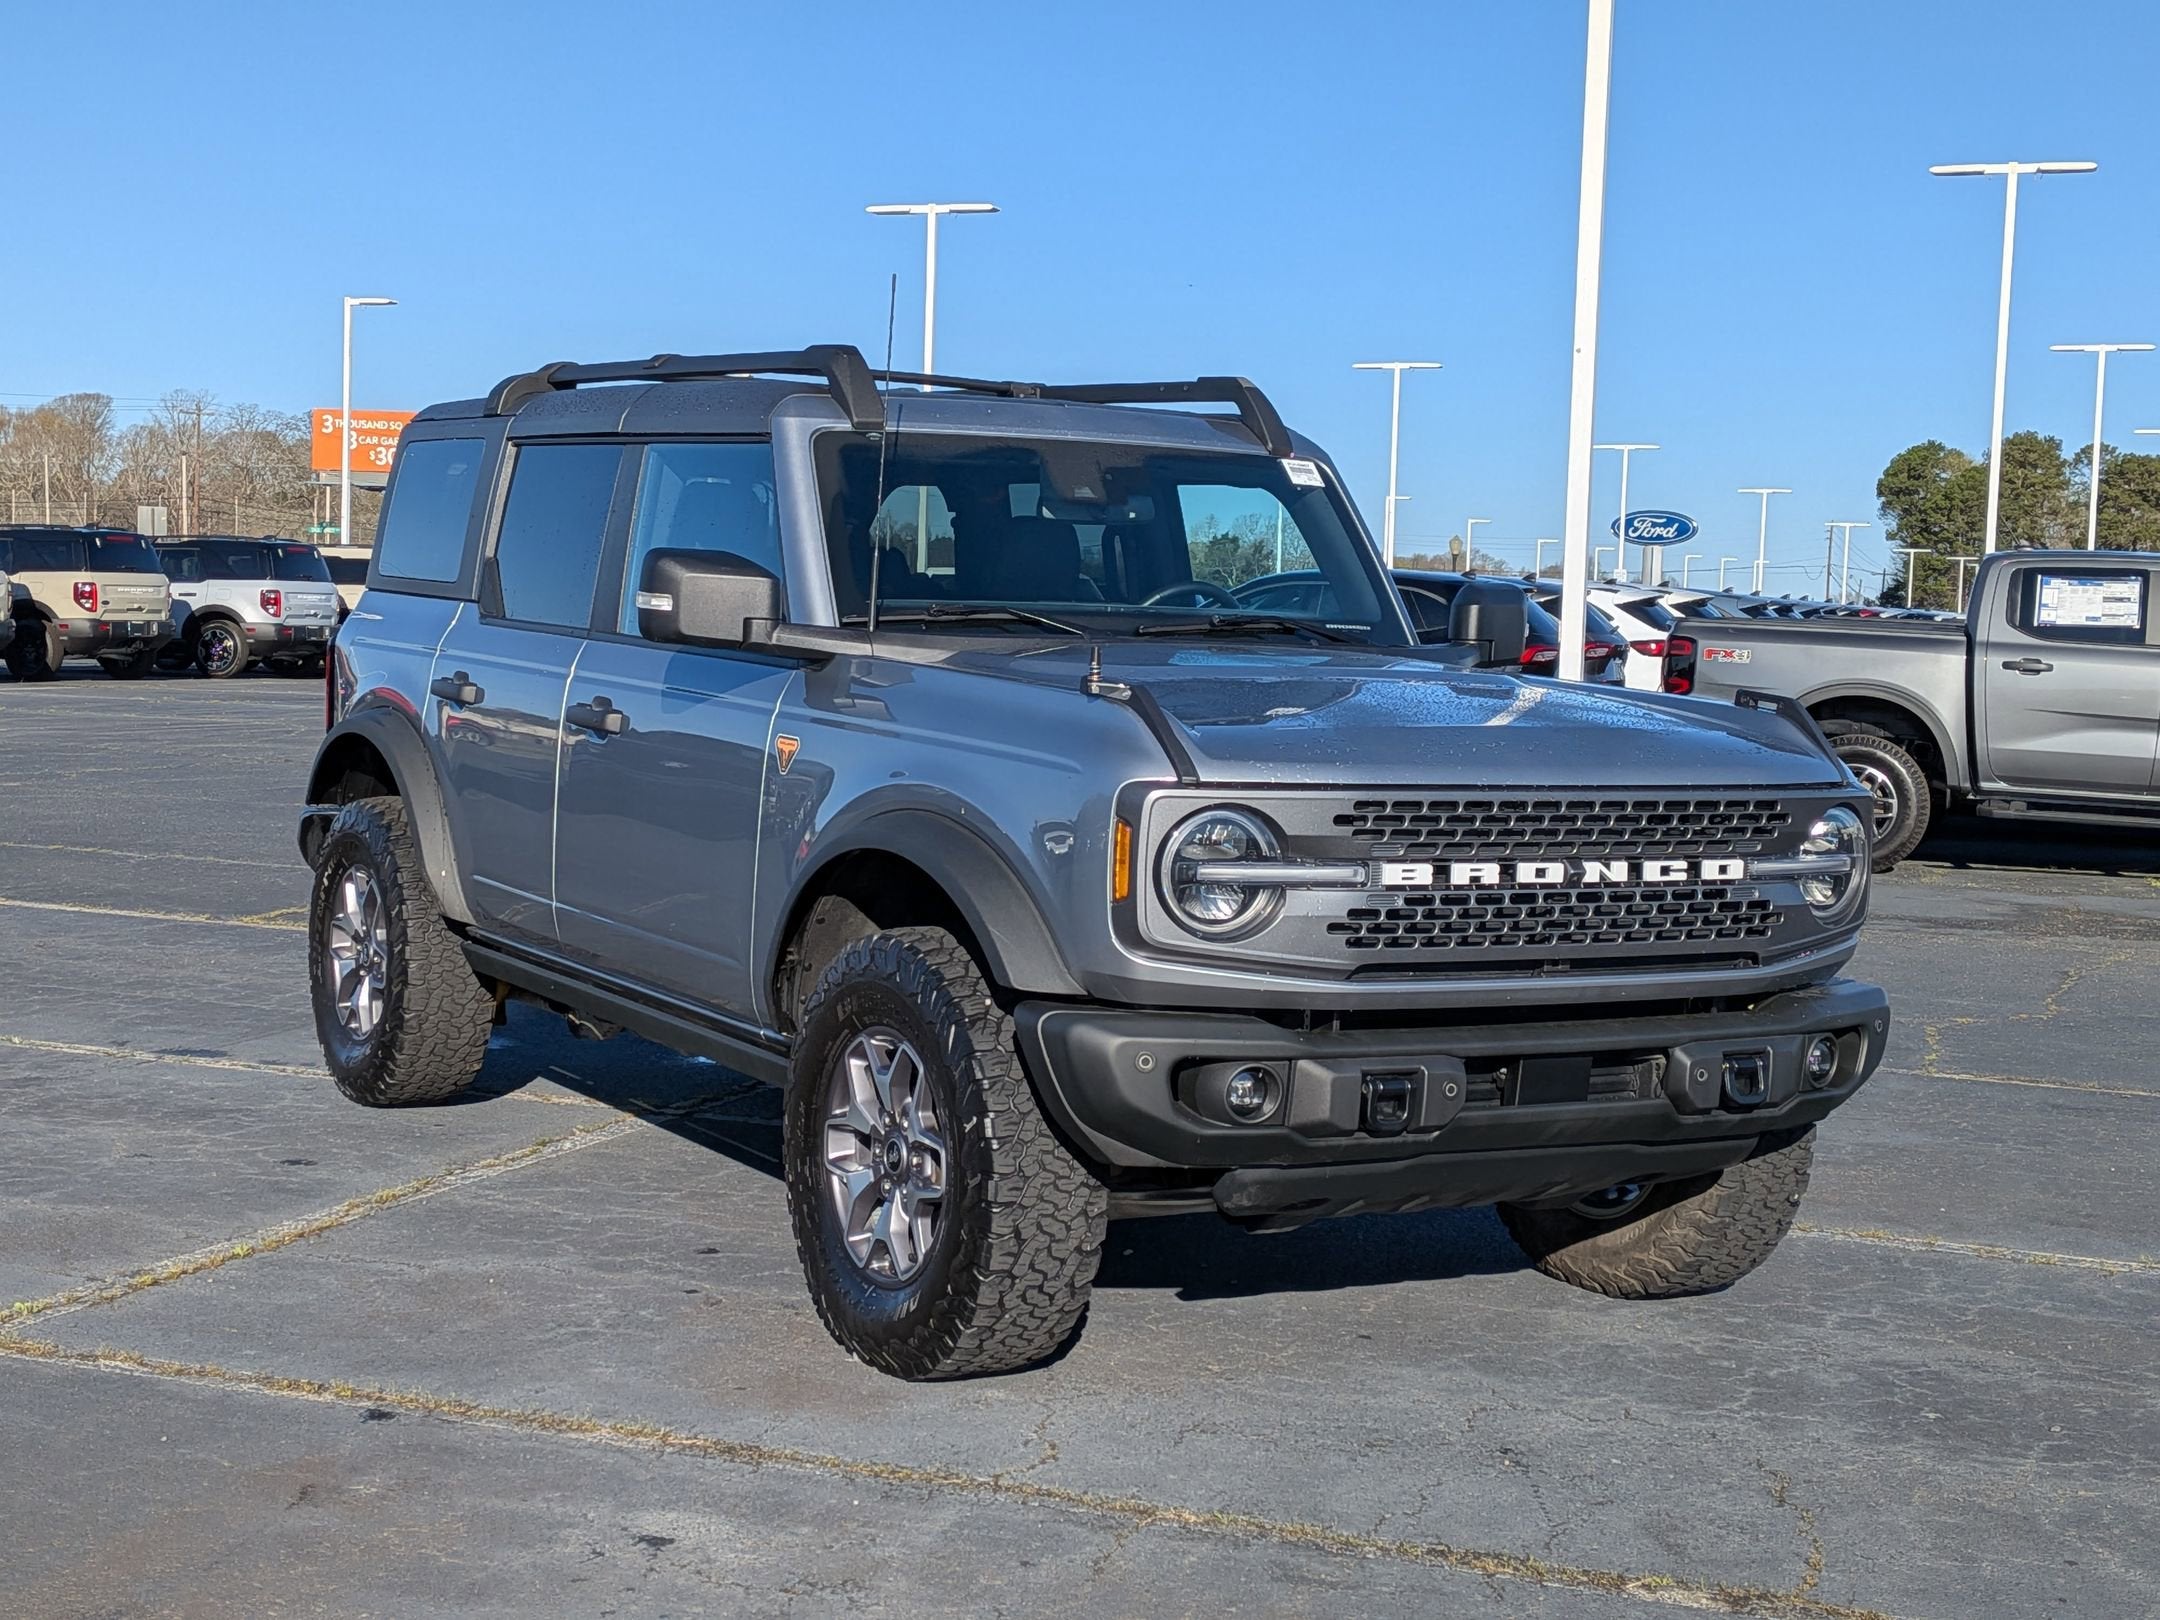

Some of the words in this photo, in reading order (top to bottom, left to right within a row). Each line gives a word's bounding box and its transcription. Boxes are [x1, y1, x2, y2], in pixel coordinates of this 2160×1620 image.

[322, 415, 333, 434] 3
[358, 435, 379, 445] CAR
[1628, 517, 1679, 538] Ford
[1703, 647, 1751, 662] FX4
[1381, 859, 1744, 886] BRONCO
